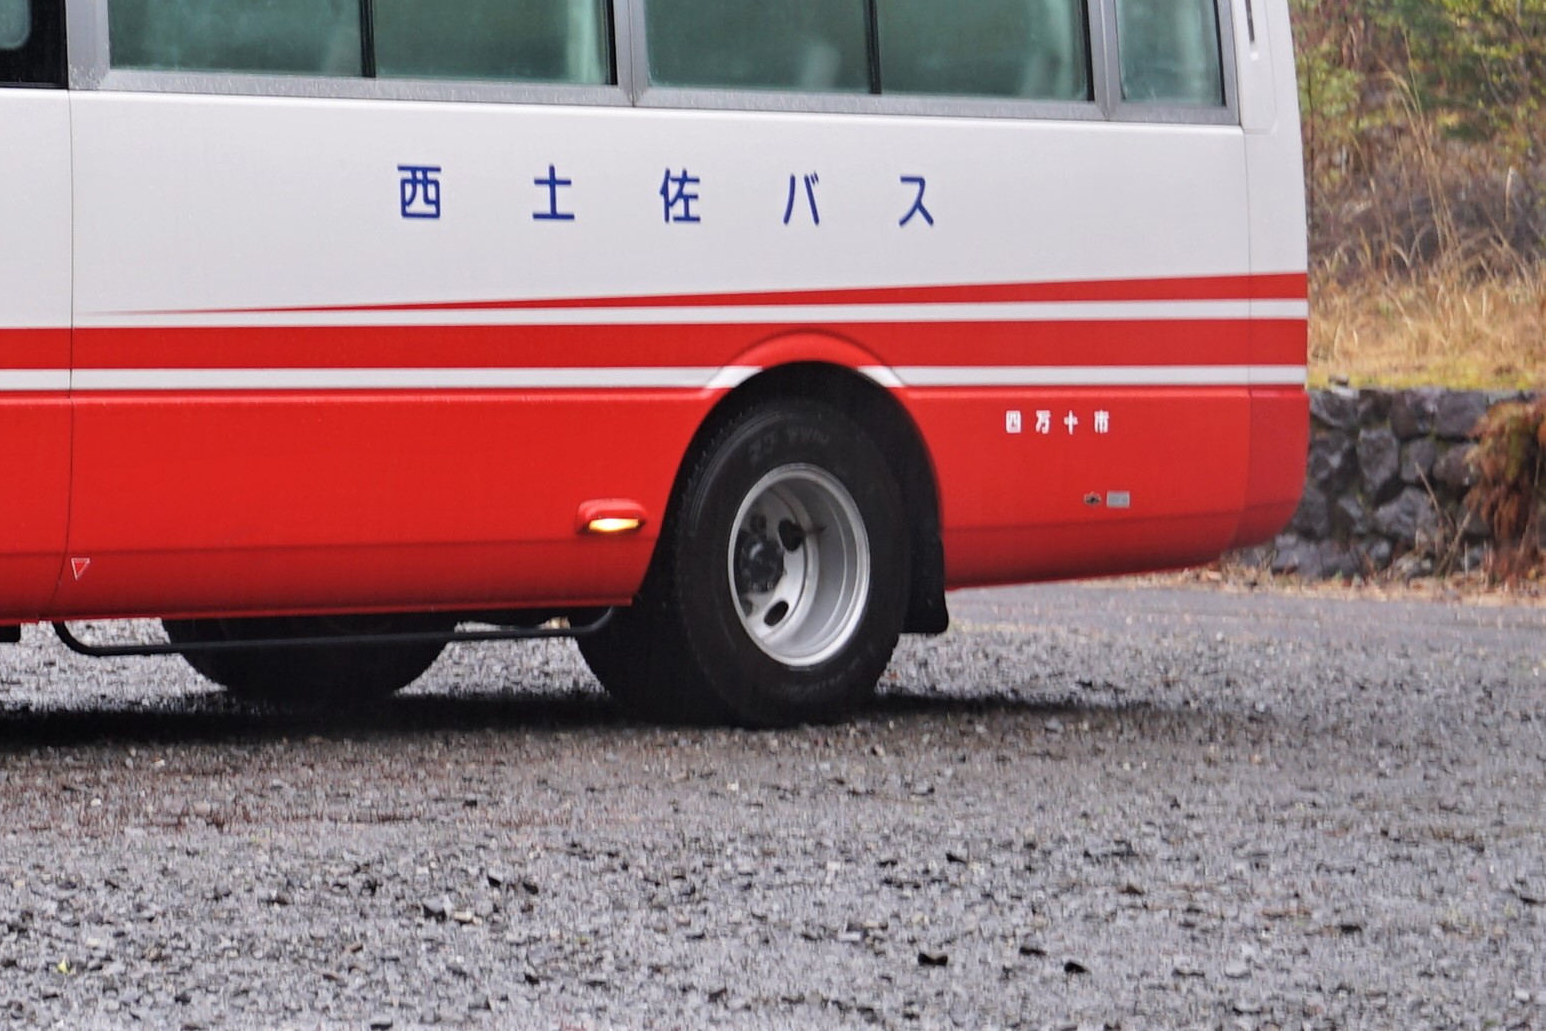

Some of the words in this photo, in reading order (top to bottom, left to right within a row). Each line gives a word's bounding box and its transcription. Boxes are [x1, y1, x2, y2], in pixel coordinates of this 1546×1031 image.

[397, 164, 935, 227] 西土佐バス
[1005, 409, 1110, 435] 四万十市
